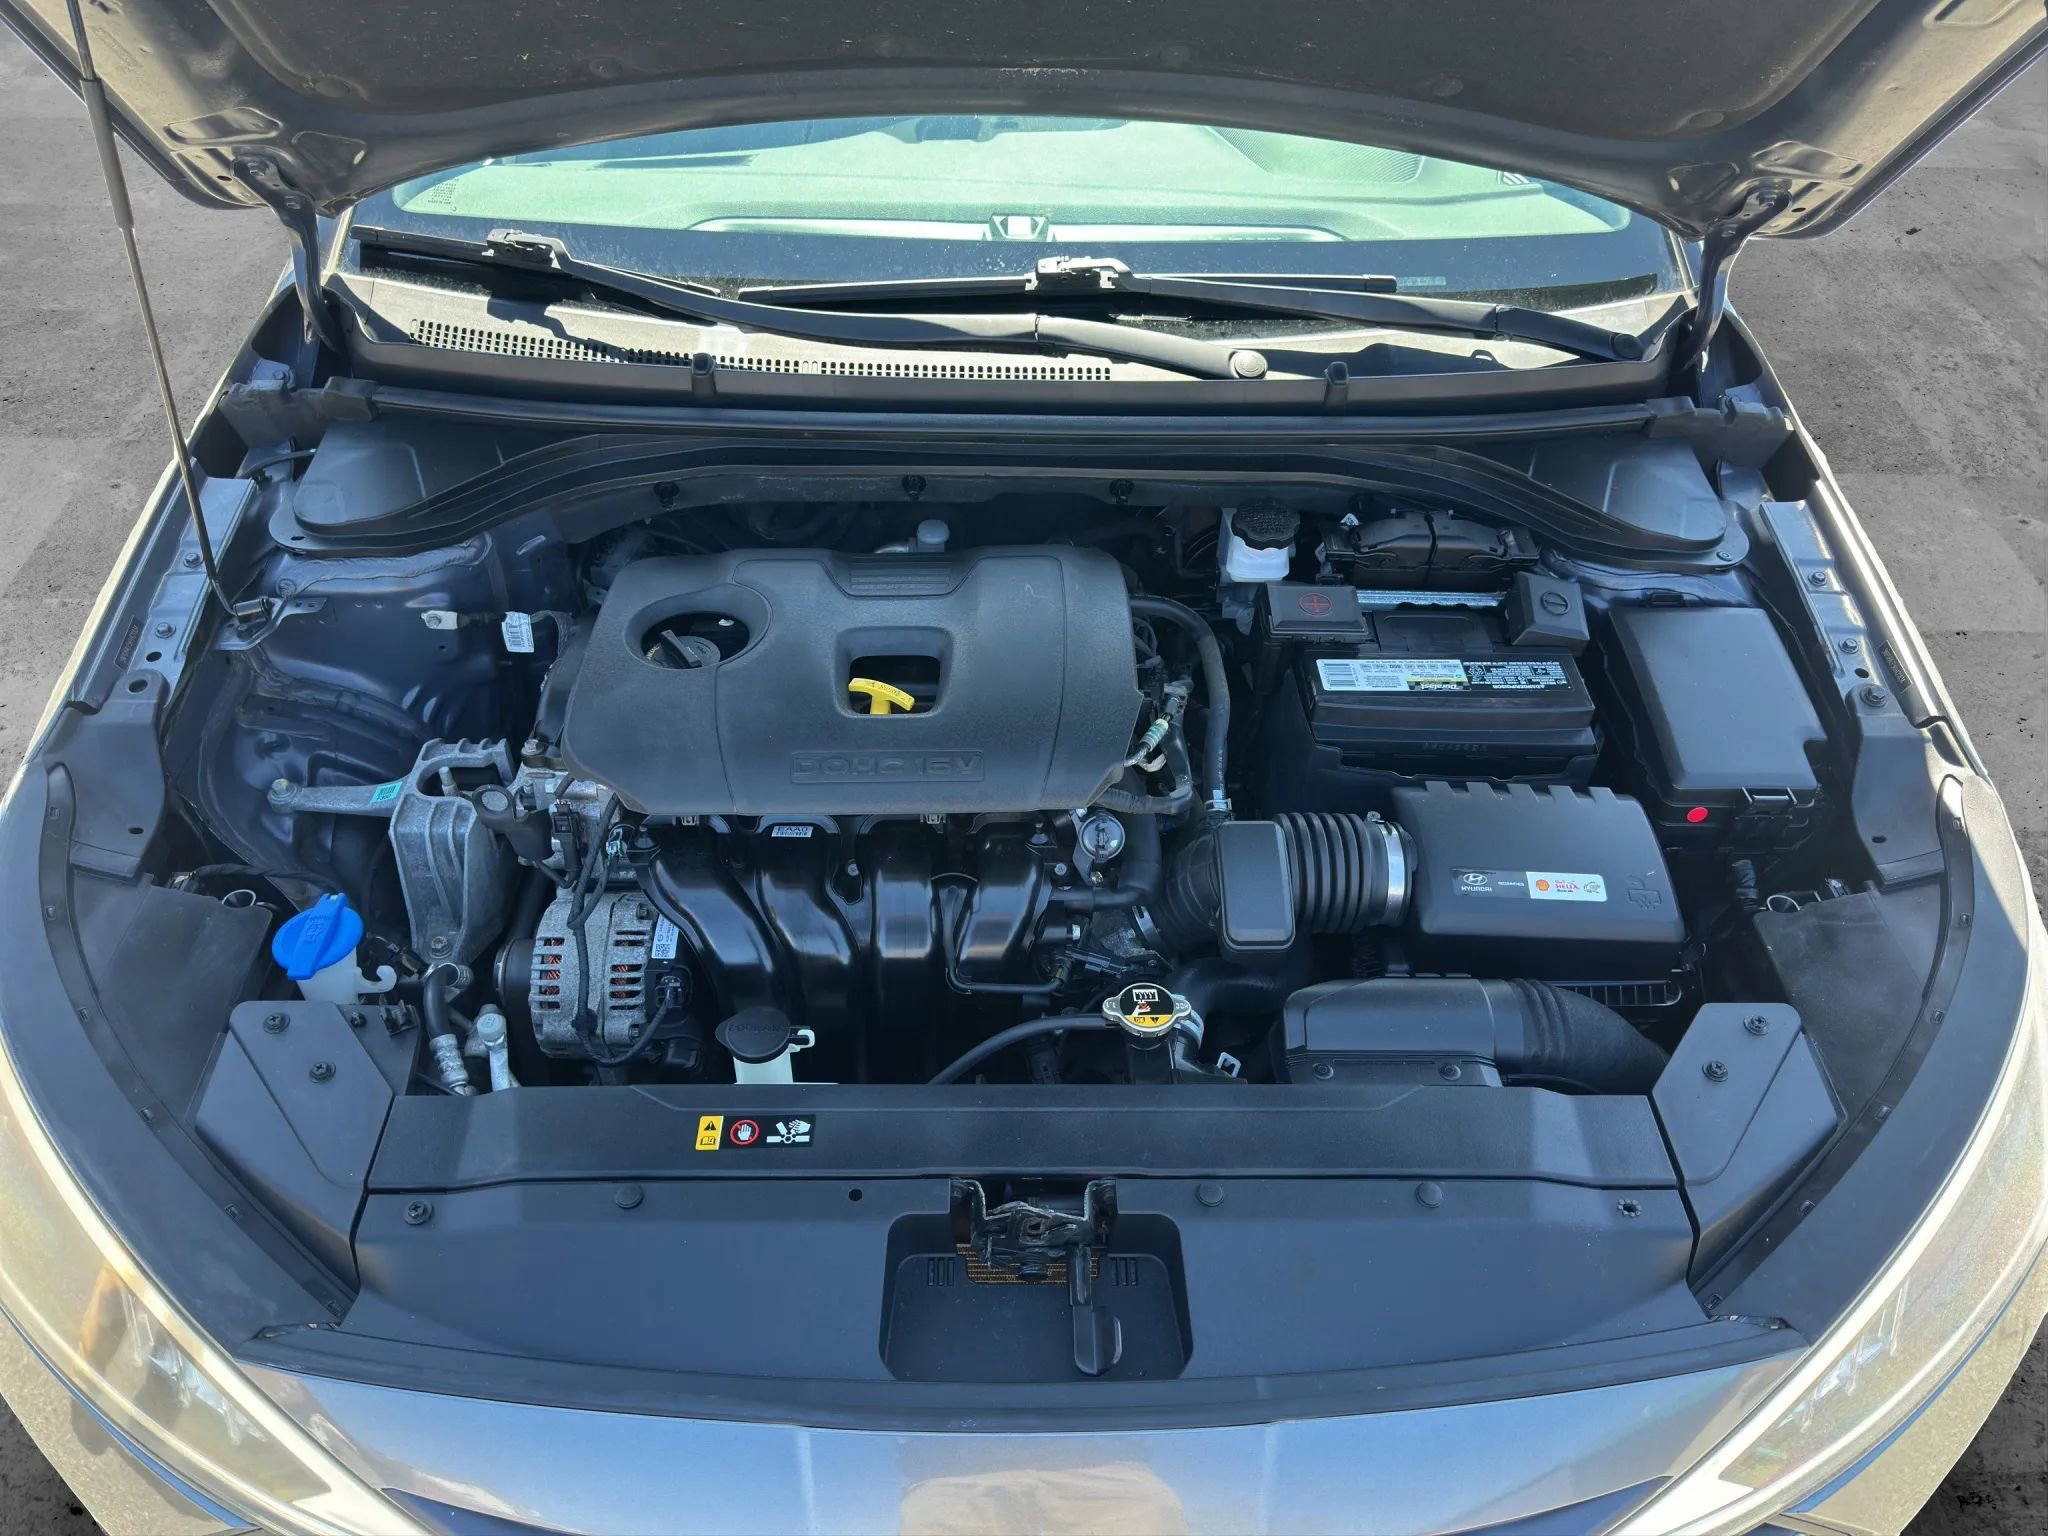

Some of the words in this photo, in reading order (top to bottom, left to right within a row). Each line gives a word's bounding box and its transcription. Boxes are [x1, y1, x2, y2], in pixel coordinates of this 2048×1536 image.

[1419, 682, 1457, 690] Duralast
[793, 757, 904, 776] DOHC
[915, 755, 982, 776] 16V
